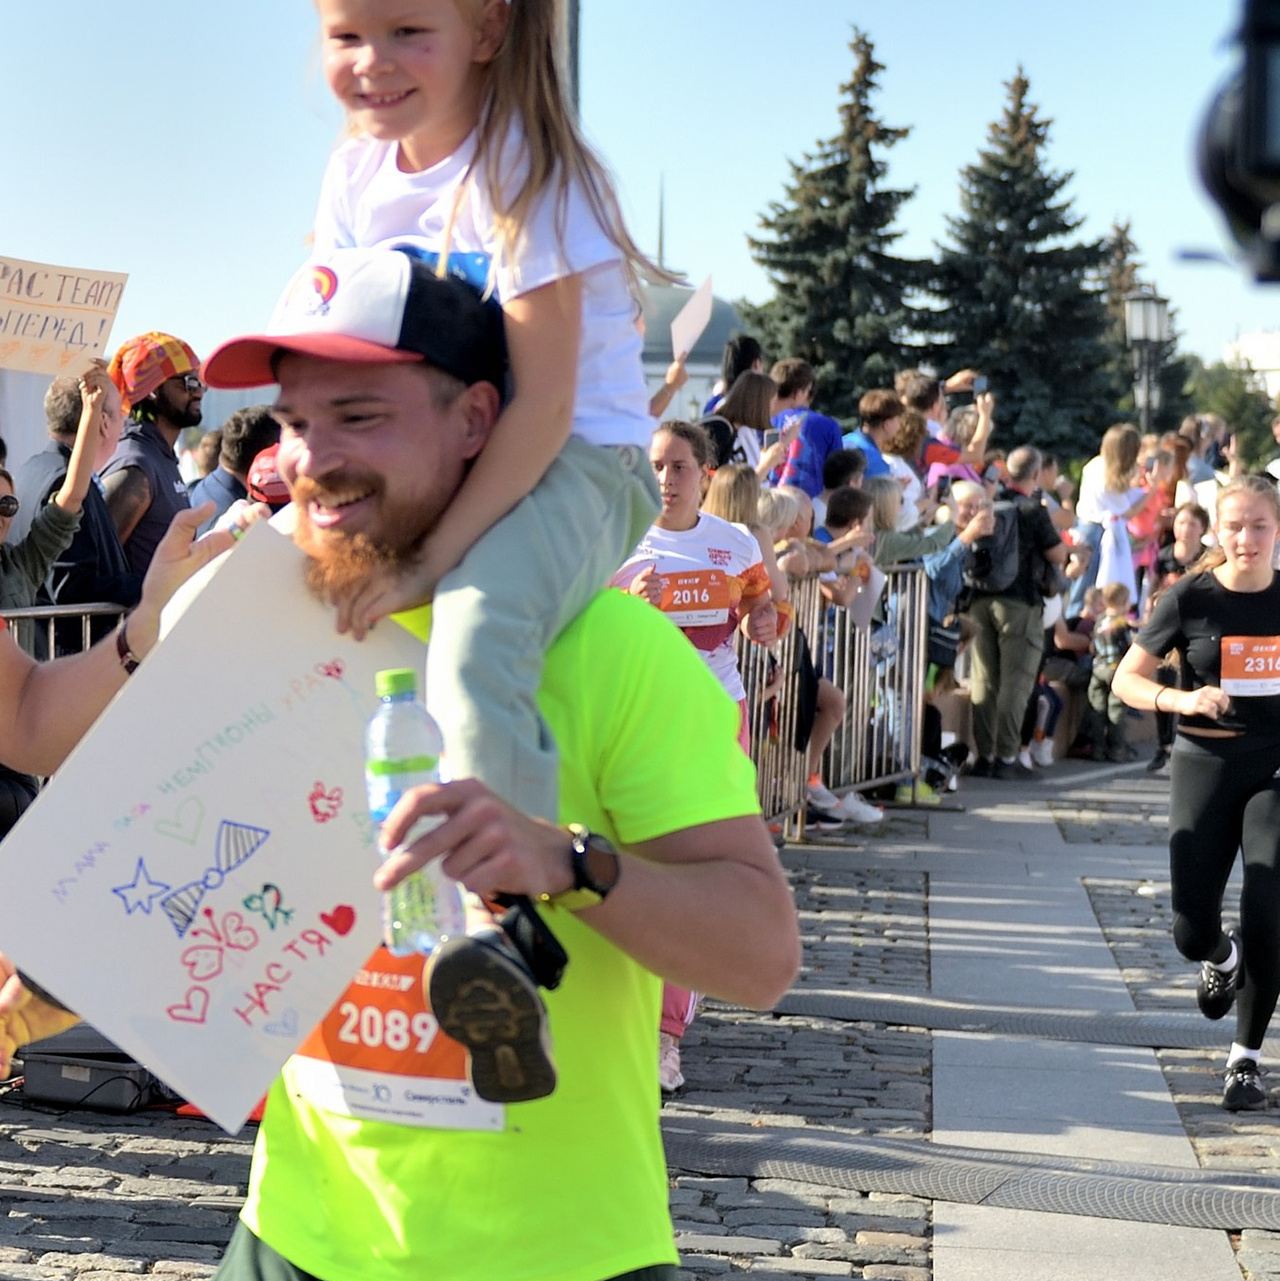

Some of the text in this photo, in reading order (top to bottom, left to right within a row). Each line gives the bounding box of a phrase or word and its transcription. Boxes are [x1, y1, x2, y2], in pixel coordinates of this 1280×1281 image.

[673, 589, 709, 605] 2016
[1244, 657, 1280, 672] 2316
[338, 1001, 439, 1054] 2089
